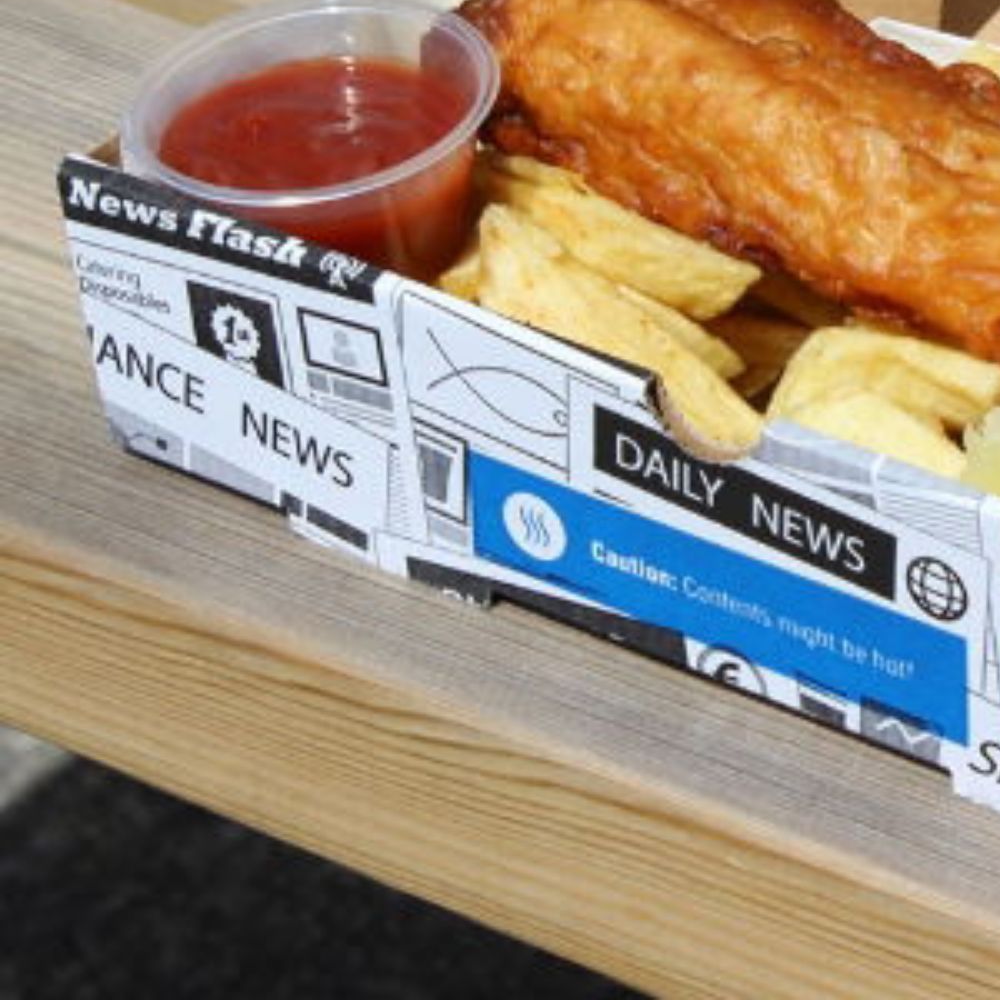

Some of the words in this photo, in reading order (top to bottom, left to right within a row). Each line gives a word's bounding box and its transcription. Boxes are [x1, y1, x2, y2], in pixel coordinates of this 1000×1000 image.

[69, 176, 178, 231] News
[186, 208, 309, 267] Flash
[240, 401, 354, 489] NEWS
[613, 431, 726, 510] DAILY
[749, 493, 867, 573] NEWS
[589, 538, 678, 592] Caution:
[682, 575, 772, 628] Contents
[777, 613, 836, 650] might
[841, 636, 868, 665] be
